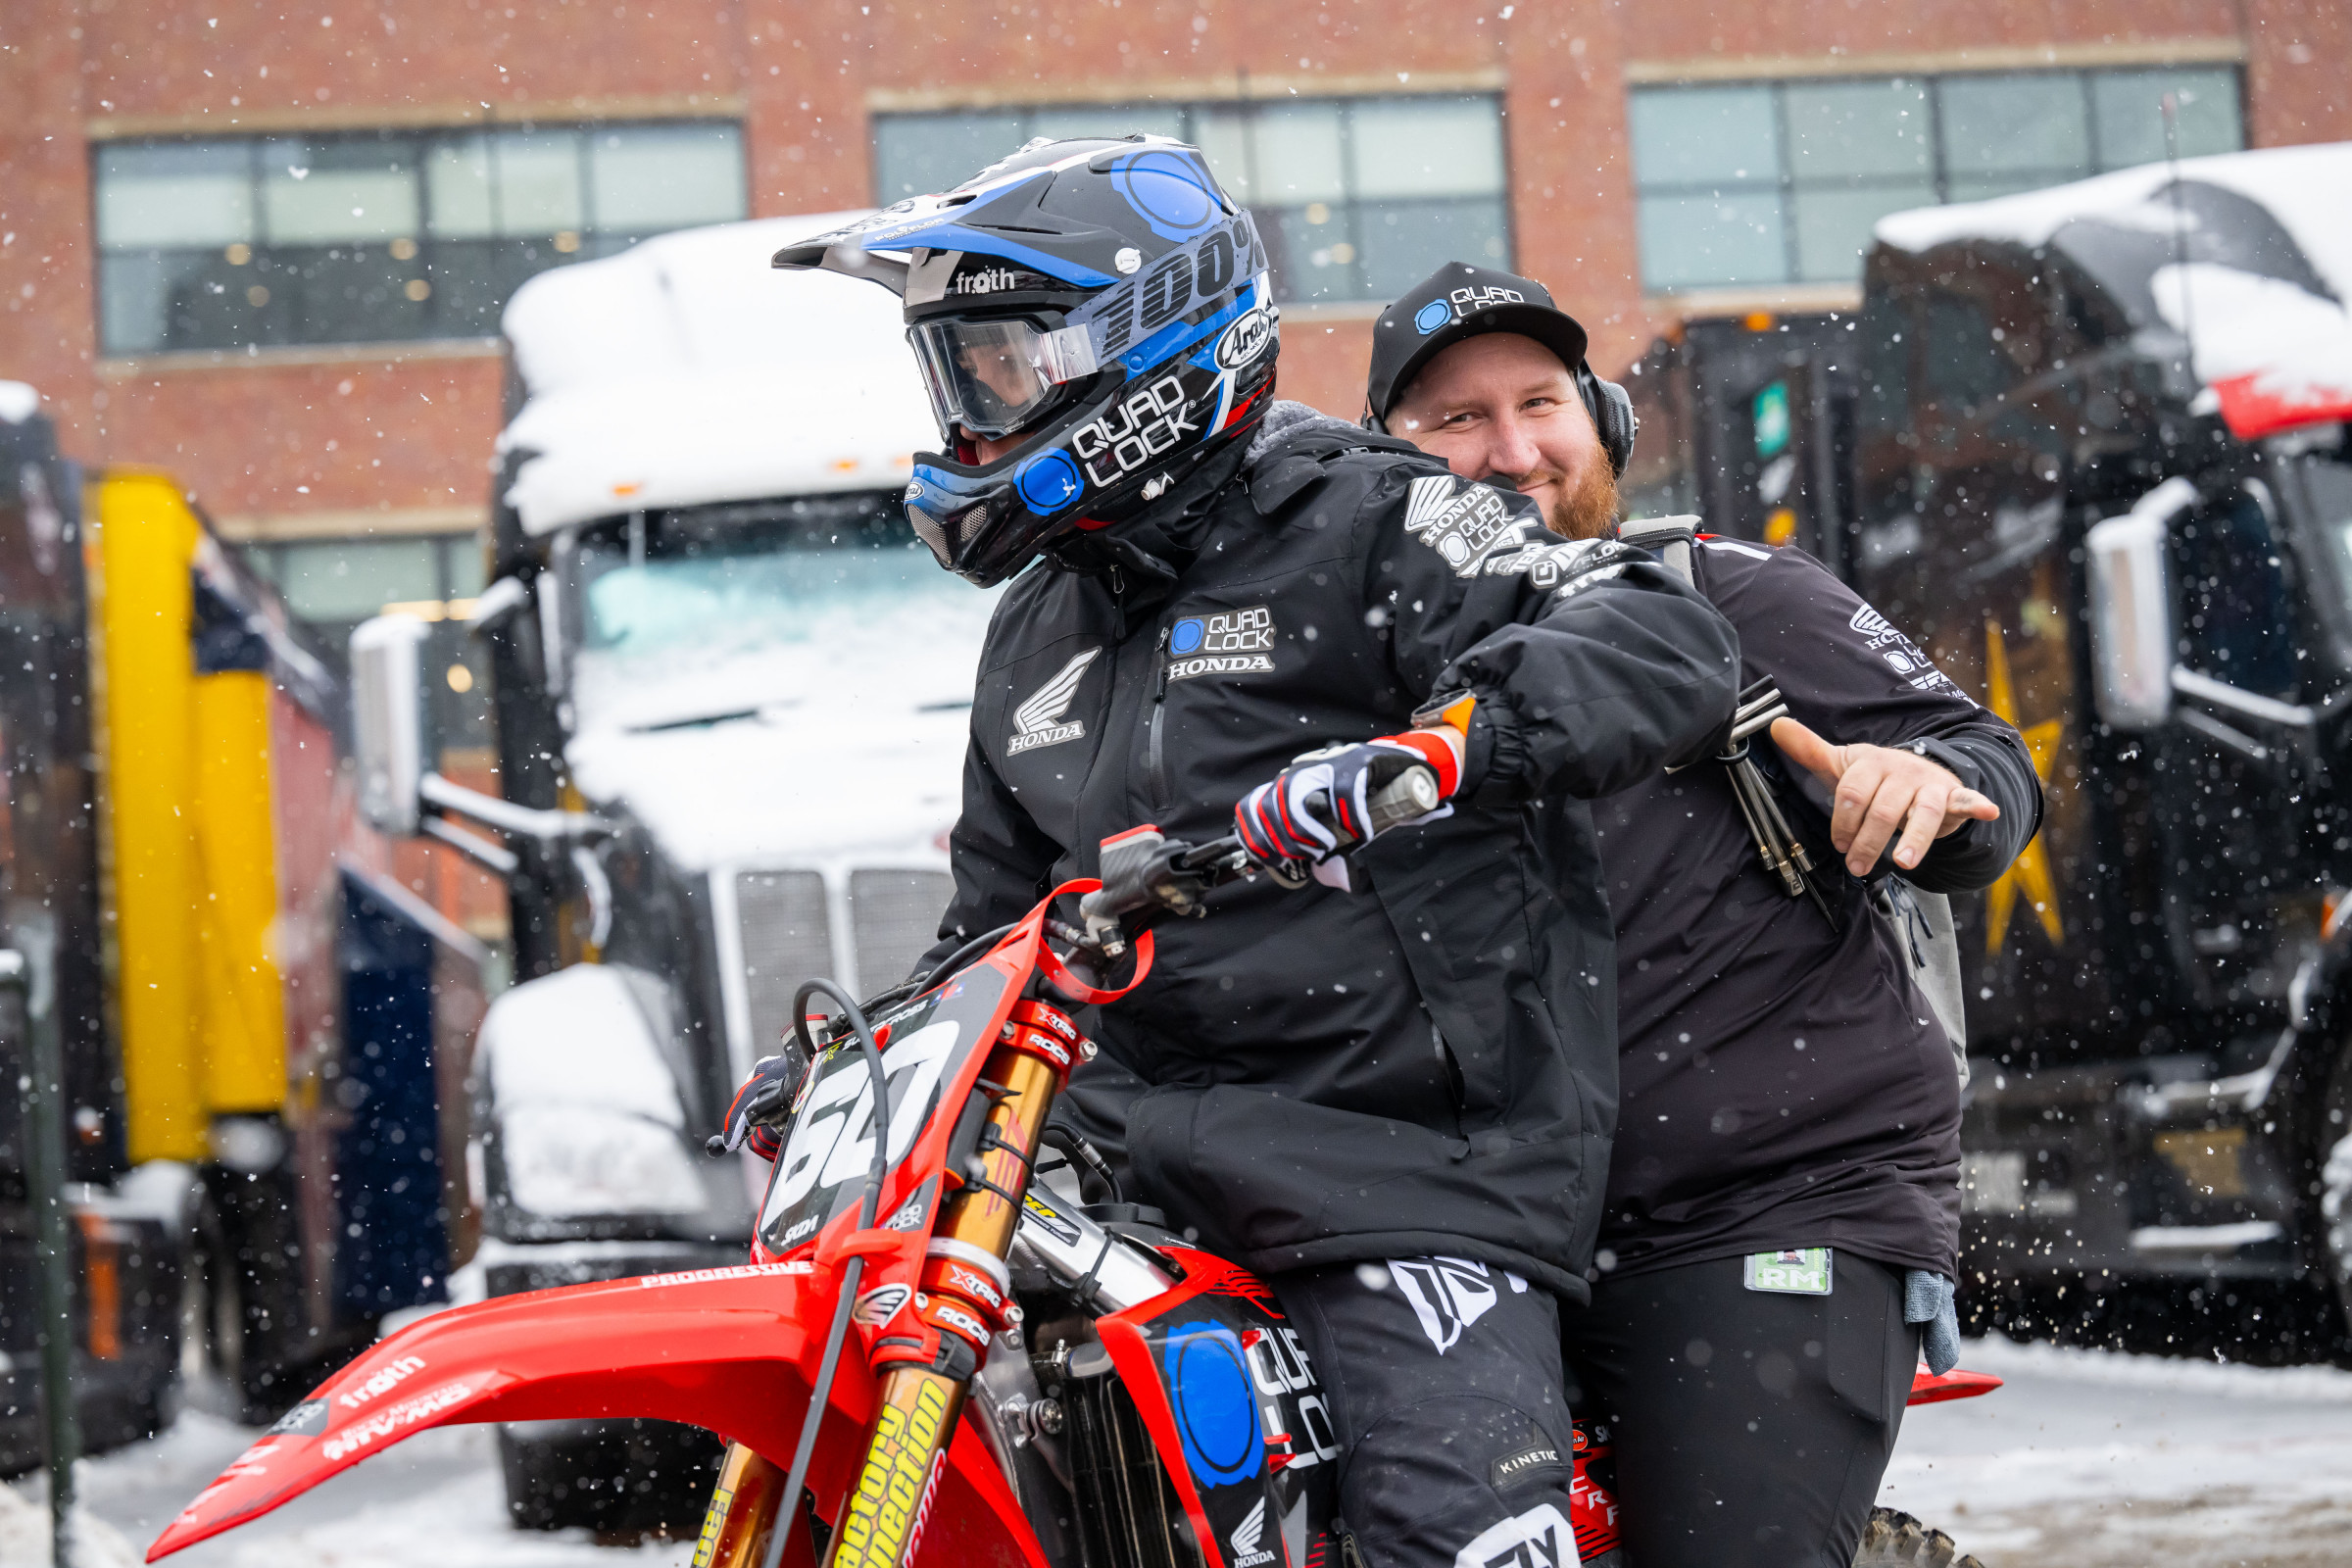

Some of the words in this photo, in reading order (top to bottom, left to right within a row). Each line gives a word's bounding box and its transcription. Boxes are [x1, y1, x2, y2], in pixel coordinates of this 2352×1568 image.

[956, 266, 1015, 294] froth
[1092, 218, 1264, 359] 100%
[1450, 286, 1524, 304] QUAD
[1072, 375, 1185, 459] QUAD
[1085, 402, 1200, 488] LOCK
[1422, 485, 1491, 543] HONDA
[1458, 495, 1503, 537] QUAD
[1468, 510, 1514, 551] LOCK
[1208, 608, 1270, 634] QUAD
[1204, 627, 1272, 651] LOCK
[1169, 656, 1272, 680] HONDA
[1008, 724, 1082, 753] HONDA
[1037, 1007, 1077, 1041] XTRIG
[1029, 1034, 1071, 1066] ROCS
[640, 1260, 814, 1289] PROGRESSIVE
[949, 1264, 1002, 1308] XTRIG
[936, 1305, 991, 1347] ROCS
[339, 1356, 425, 1408] froth
[1499, 1449, 1558, 1474] KINETIC
[834, 1402, 907, 1568] actory
[1234, 1550, 1276, 1568] HONDA
